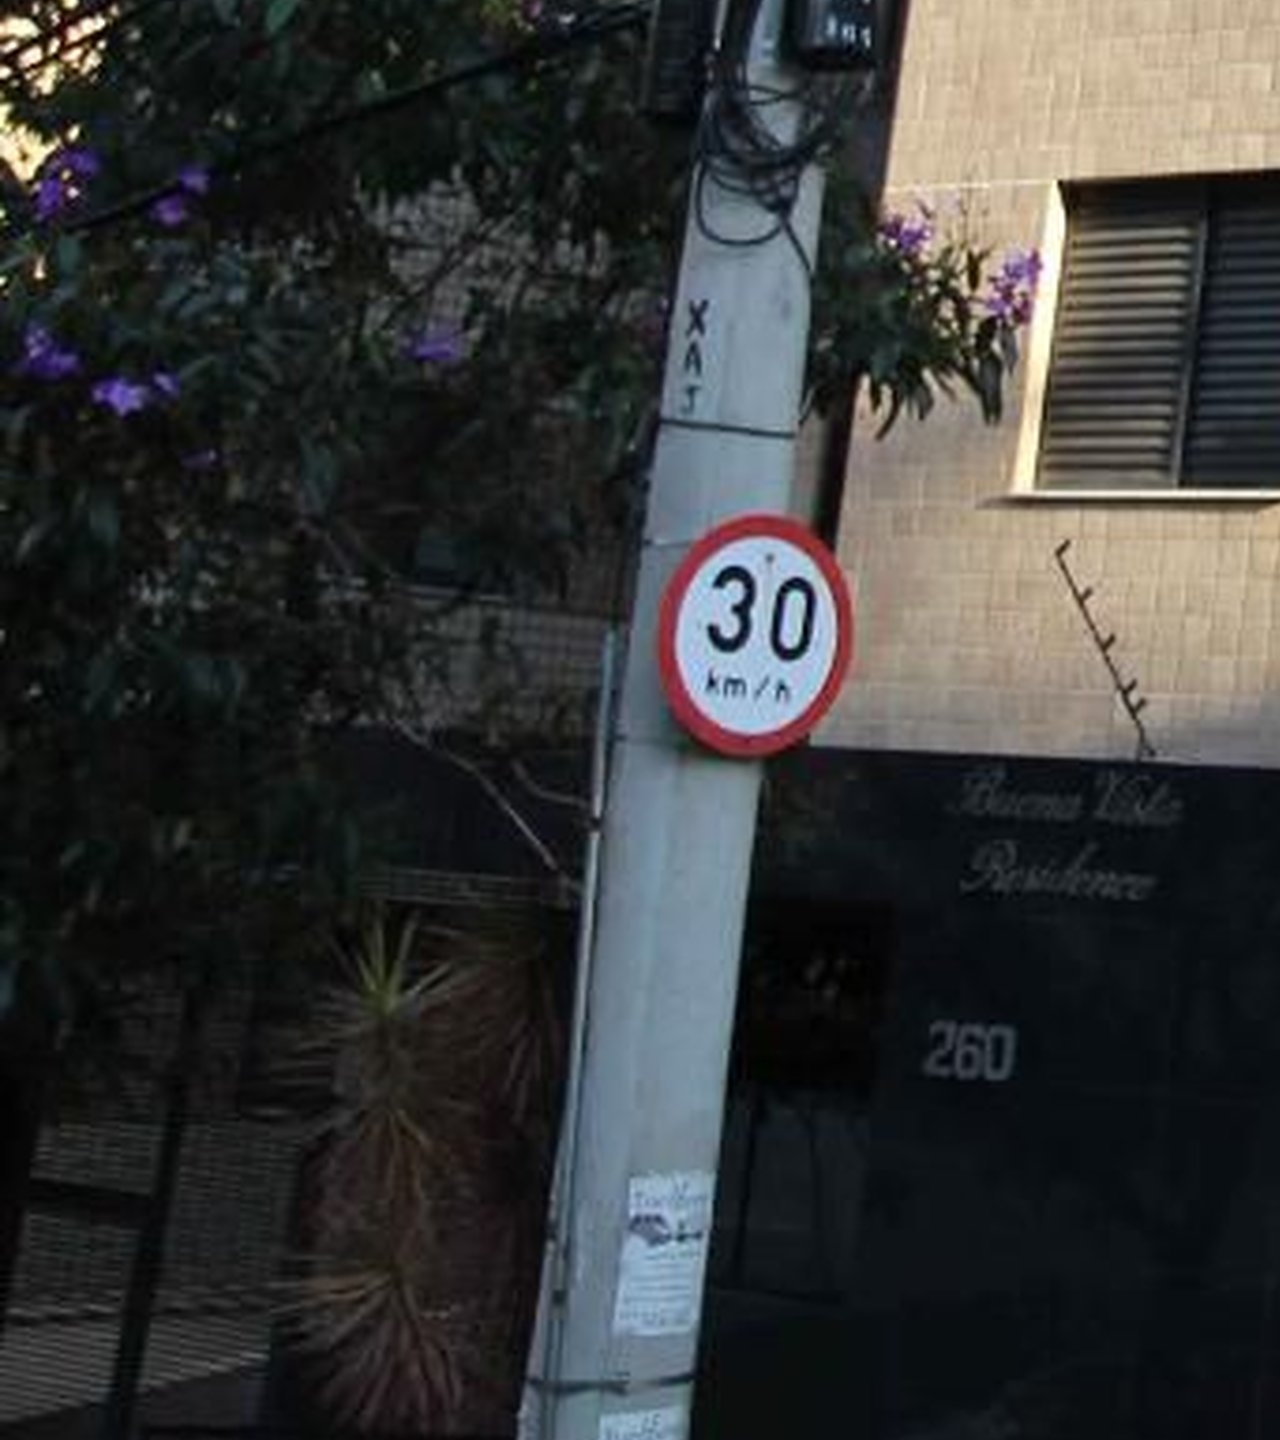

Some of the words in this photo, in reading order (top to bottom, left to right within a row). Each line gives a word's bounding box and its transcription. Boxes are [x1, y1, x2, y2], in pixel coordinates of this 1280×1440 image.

[706, 565, 816, 662] 30
[705, 669, 793, 704] km/h
[923, 1020, 1016, 1080] 260
